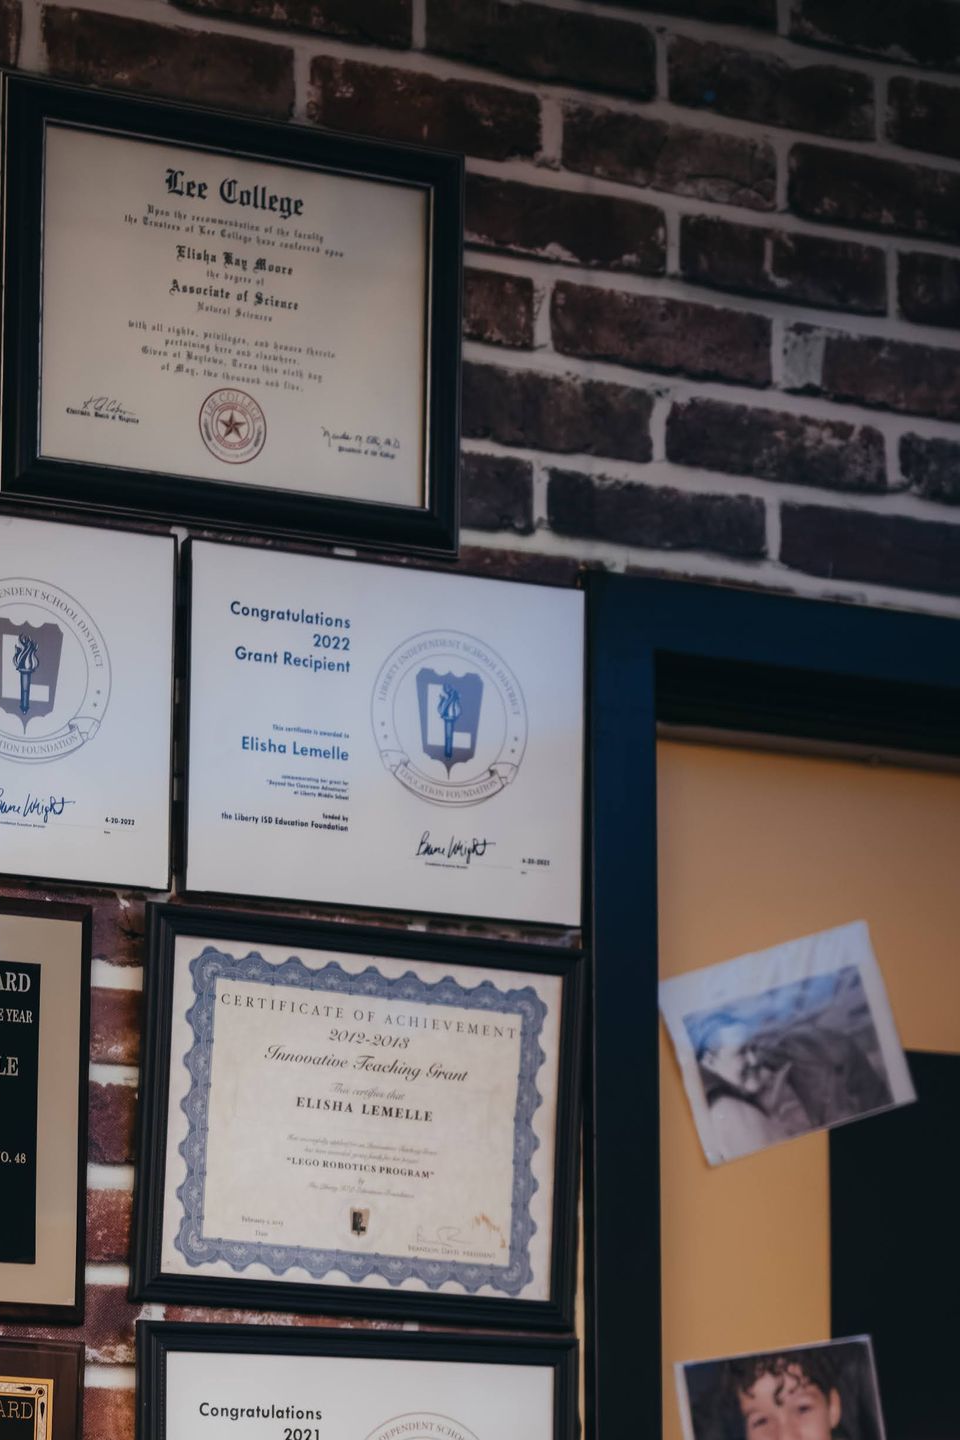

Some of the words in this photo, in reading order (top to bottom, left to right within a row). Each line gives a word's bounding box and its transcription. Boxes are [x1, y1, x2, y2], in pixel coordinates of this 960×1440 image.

[165, 168, 208, 200] Lee
[219, 178, 304, 218] College
[176, 245, 216, 265] Elisha
[223, 251, 247, 271] Kay
[253, 257, 293, 275] Moore
[169, 279, 231, 299] Associate
[236, 290, 248, 302] of
[254, 291, 298, 310] Science
[230, 601, 350, 629] Congratulations
[313, 633, 350, 651] 2022
[235, 646, 278, 664] Grant
[283, 651, 350, 672] Recipient
[242, 736, 286, 754] Elisha
[293, 741, 349, 761] Lemelle
[6, 1008, 33, 1023] YEAR
[221, 993, 343, 1018] CERTIFICATE
[353, 1010, 375, 1022] OF
[385, 1014, 517, 1039] ACHIEVEMENT
[264, 1045, 348, 1068] Innovative
[353, 1055, 421, 1079] Teaching
[426, 1064, 468, 1081] Grant
[297, 1097, 352, 1113] ELISHA
[362, 1104, 433, 1121] LEMELLE
[14, 1153, 26, 1164] 48
[323, 1160, 377, 1174] ROBOTICS
[199, 1402, 322, 1421] Congratulations
